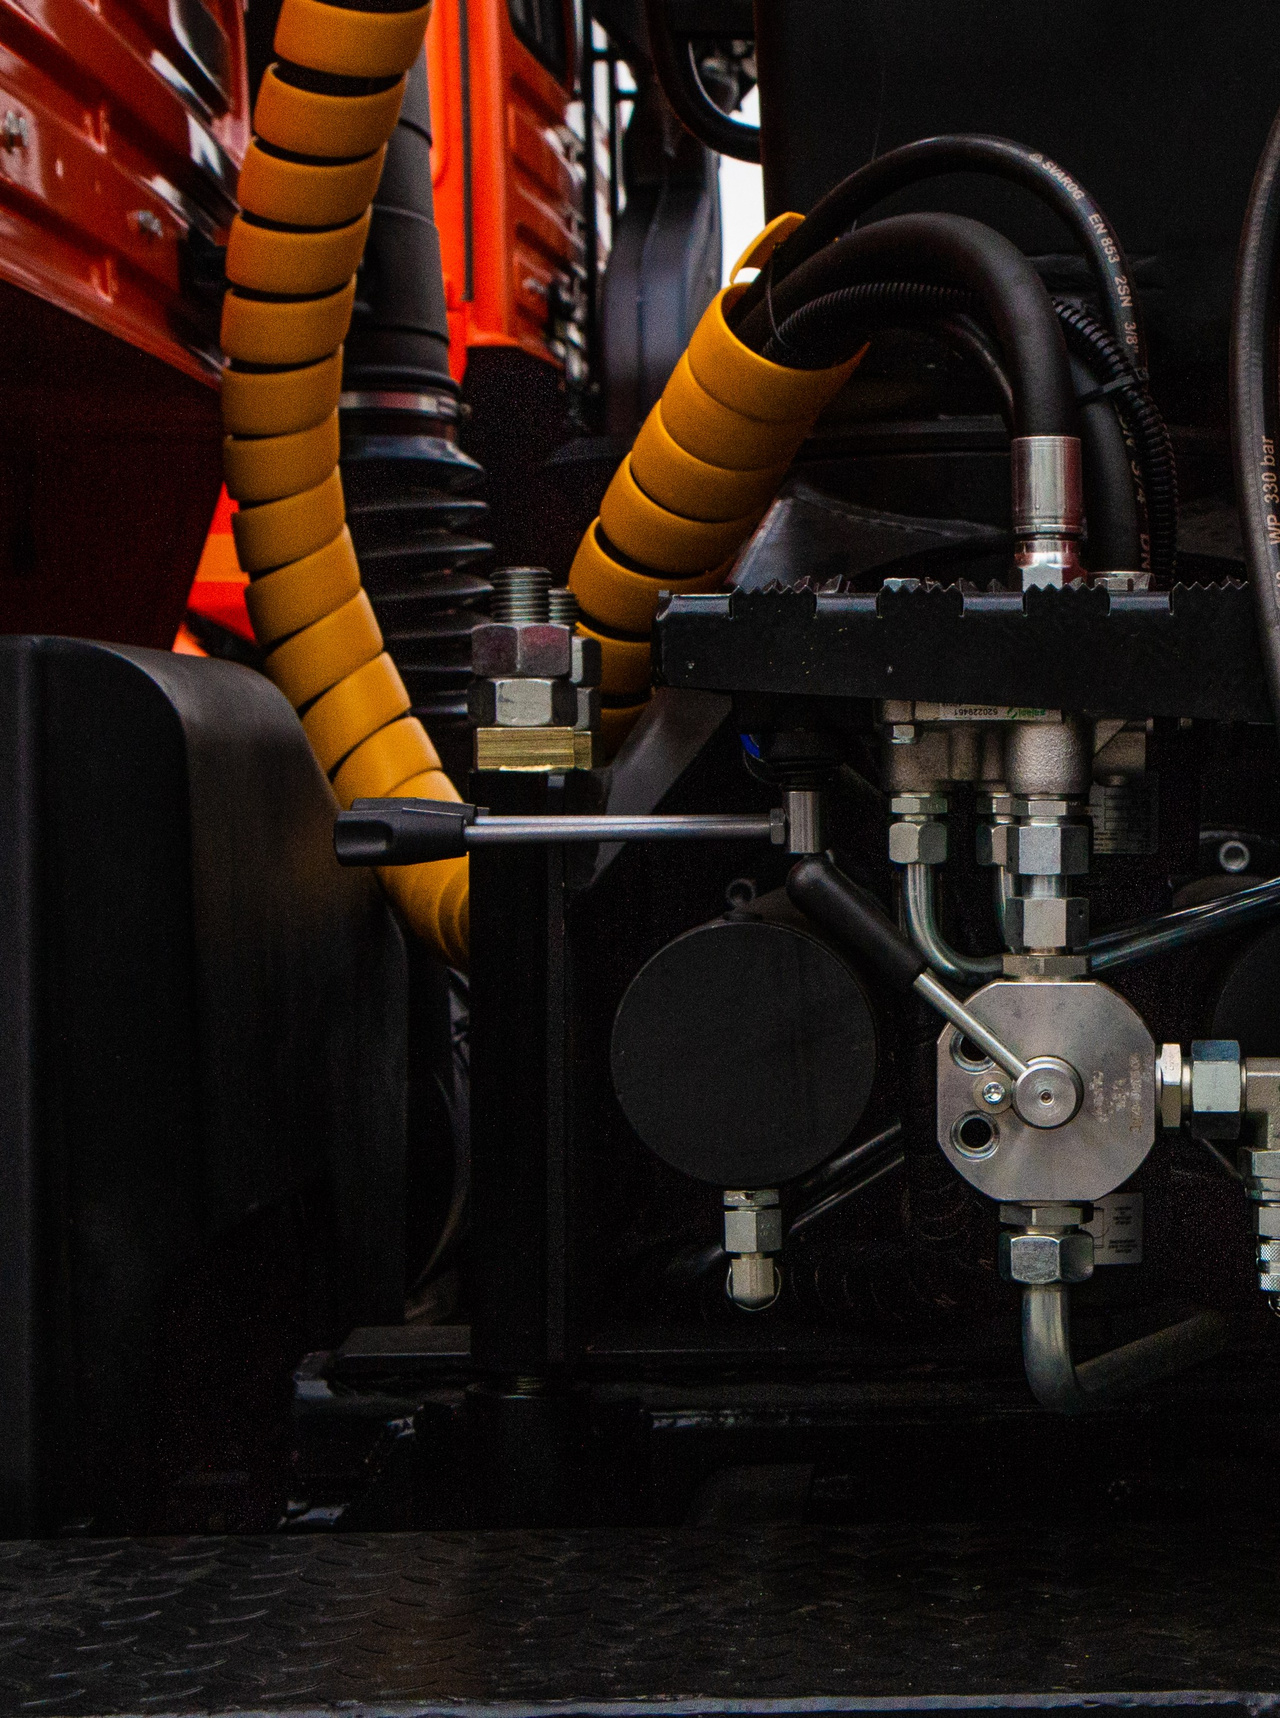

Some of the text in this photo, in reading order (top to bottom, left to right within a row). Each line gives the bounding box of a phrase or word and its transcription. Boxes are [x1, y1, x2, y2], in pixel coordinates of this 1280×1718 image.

[1042, 160, 1085, 200] SVAROG
[1088, 213, 1107, 234] EN
[1101, 237, 1120, 264] 853
[1114, 275, 1133, 308] 2SN
[1260, 435, 1275, 466] bar
[1261, 472, 1280, 503] 330
